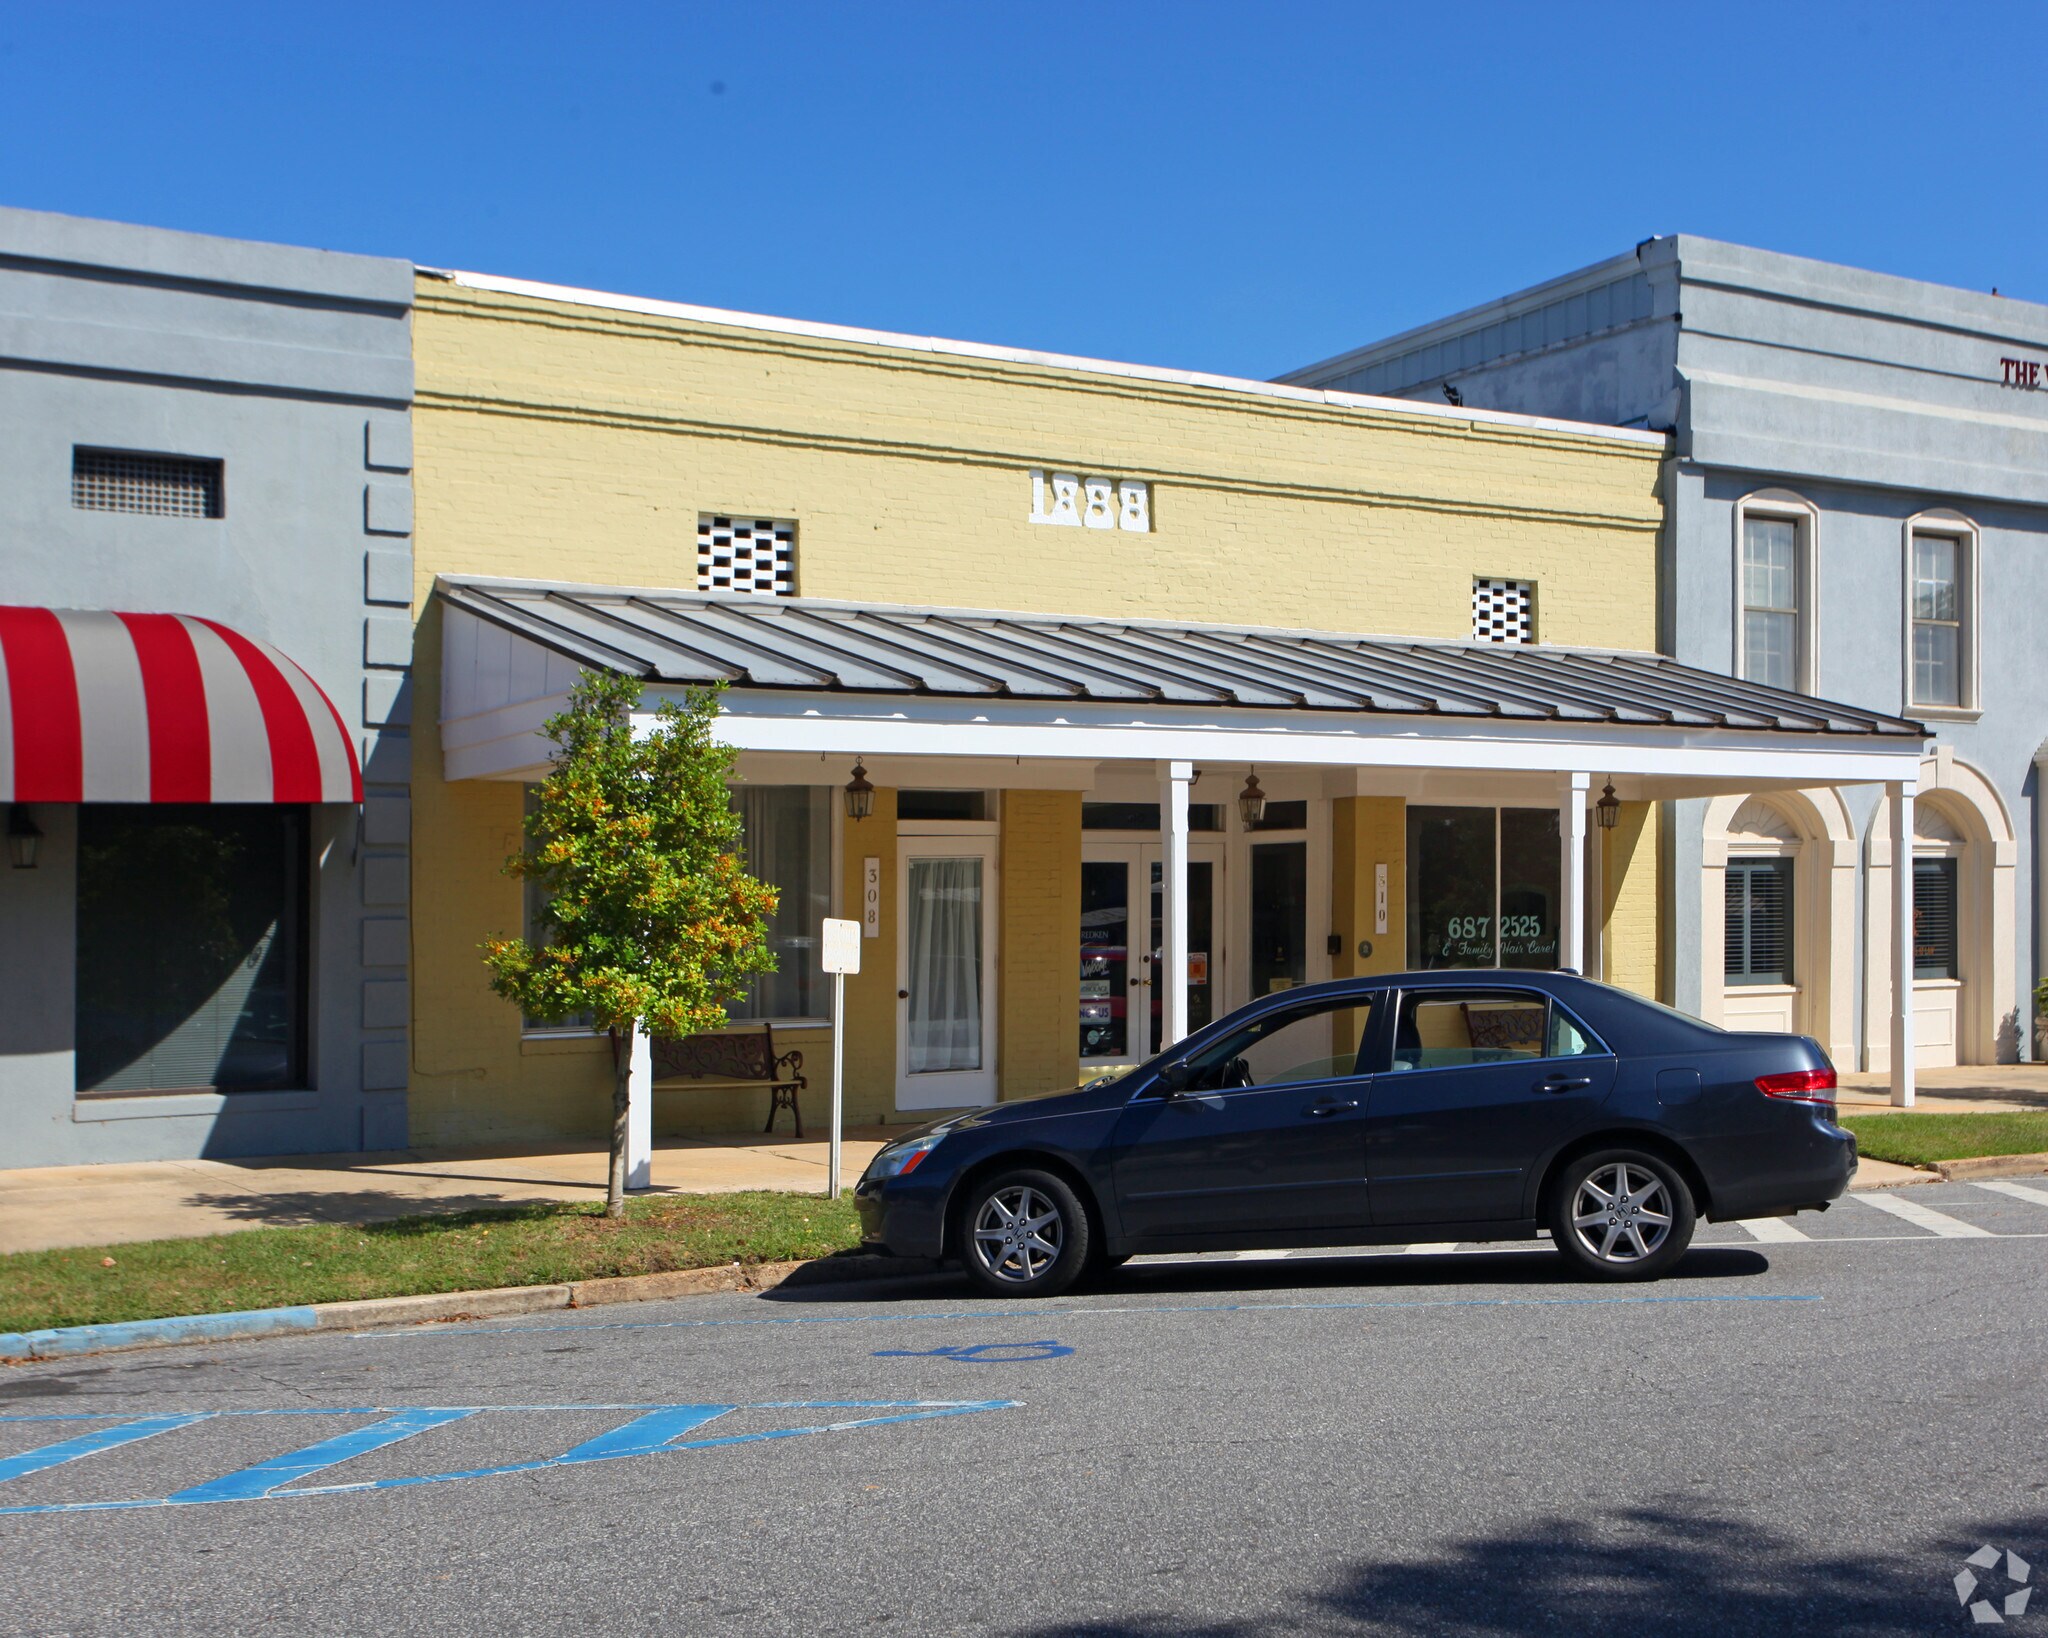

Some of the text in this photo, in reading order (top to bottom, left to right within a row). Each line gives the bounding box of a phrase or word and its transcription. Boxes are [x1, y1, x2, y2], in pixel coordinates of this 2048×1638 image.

[2000, 357, 2041, 388] THE
[1029, 468, 1150, 533] 1888
[867, 868, 877, 924] 308
[1081, 930, 1109, 940] REDKEN
[1448, 915, 1541, 939] 687 2525
[1457, 941, 1494, 959] Family
[1500, 941, 1524, 954] Hair
[1527, 940, 1556, 954] Care!
